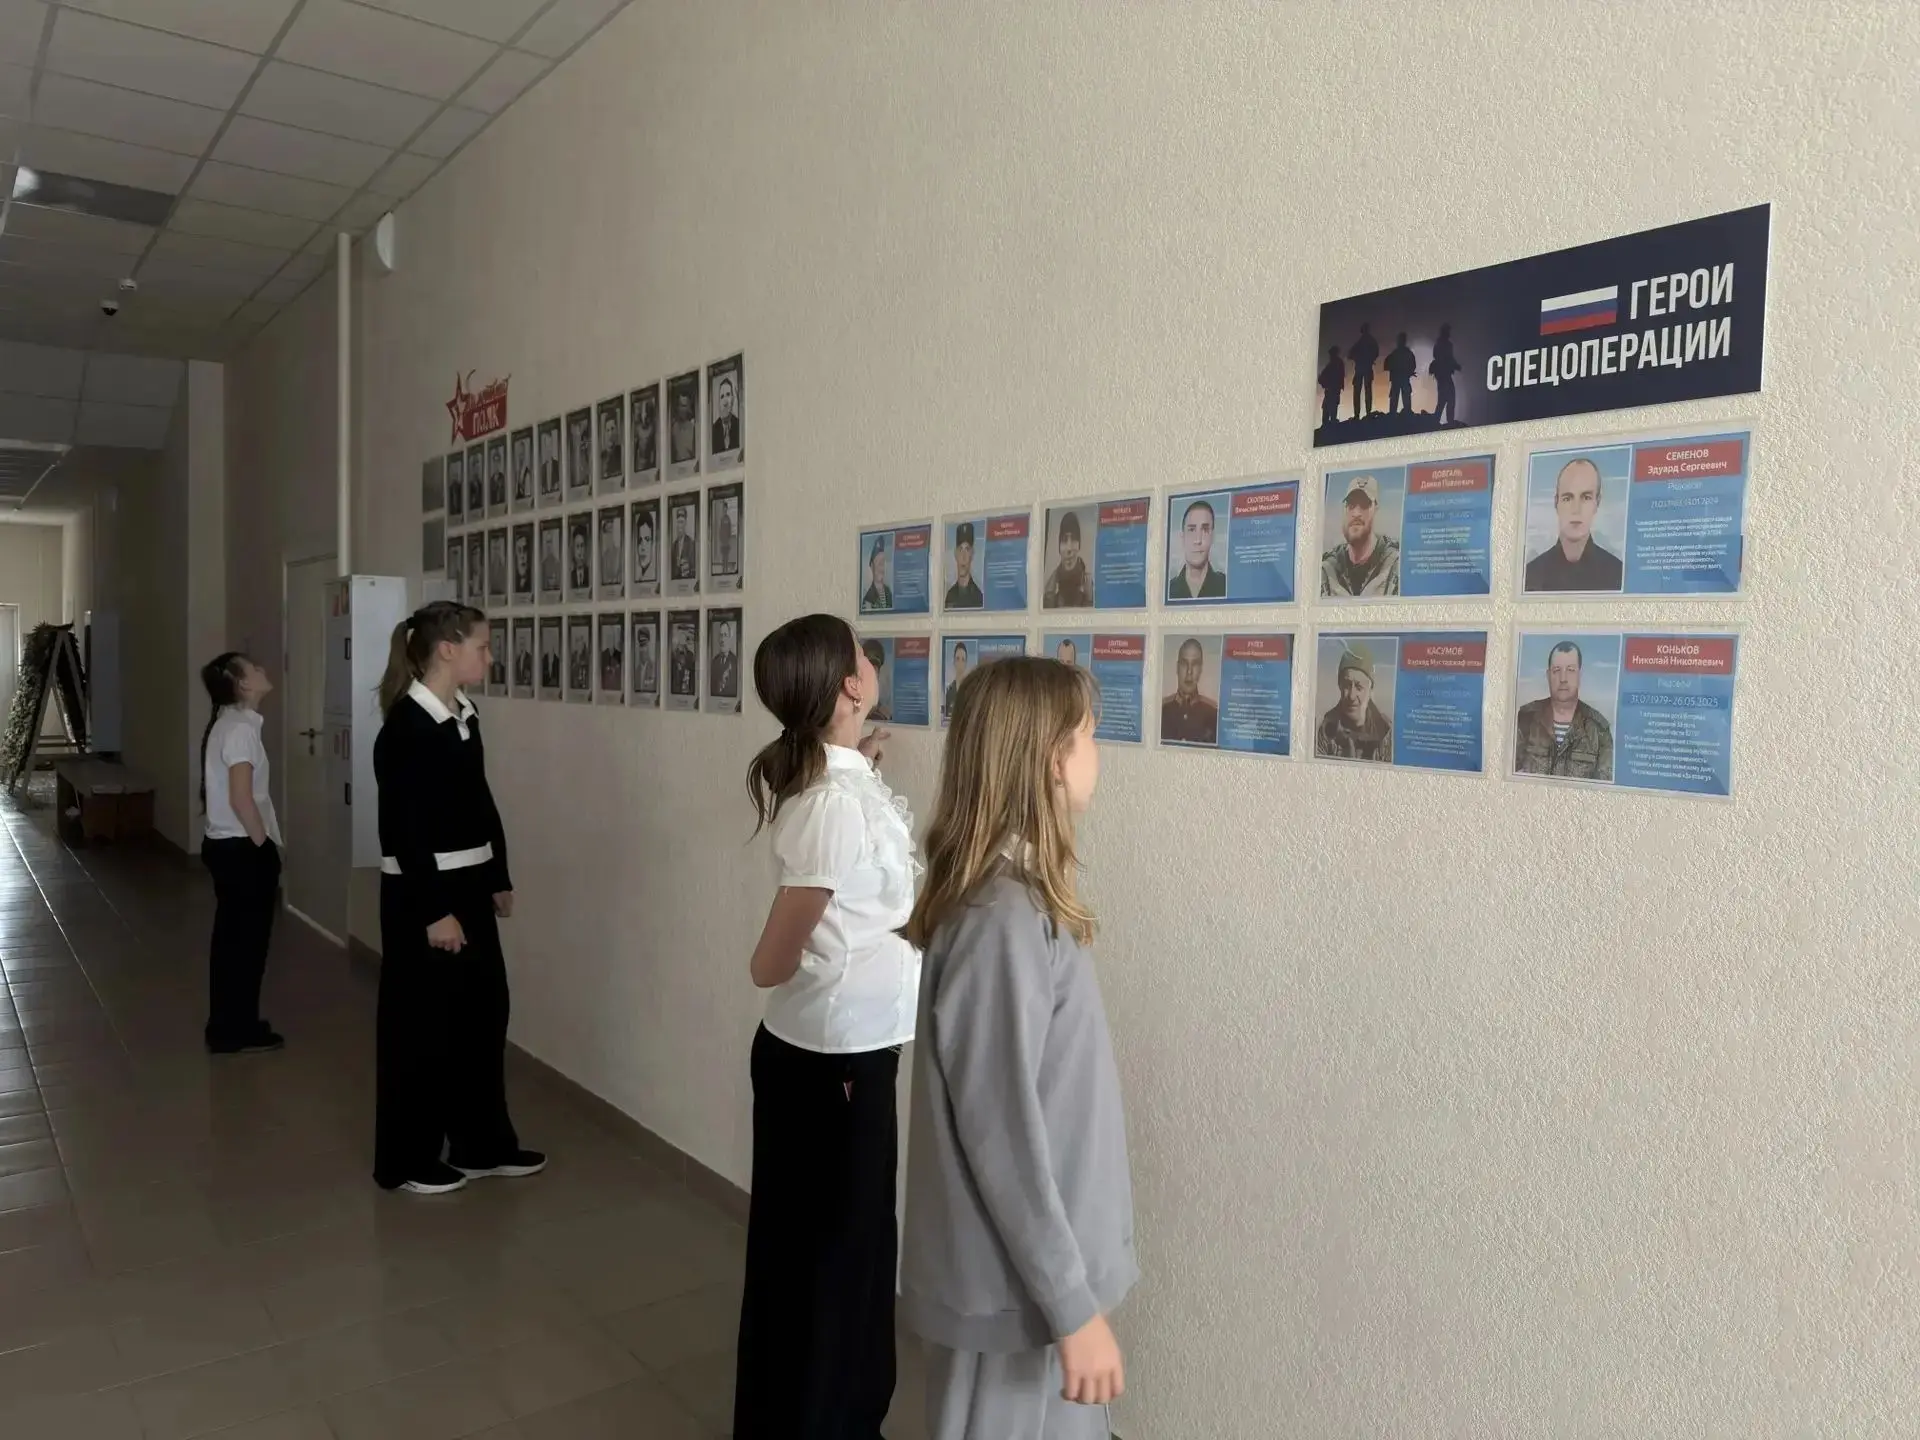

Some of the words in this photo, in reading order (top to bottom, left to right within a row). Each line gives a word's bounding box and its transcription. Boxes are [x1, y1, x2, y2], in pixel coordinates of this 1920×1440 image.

[1630, 262, 1734, 320] ГЕРОИ
[1486, 316, 1731, 391] СПЕЦОПЕРАЦИИ
[1665, 448, 1709, 461] СЕМЕНОВ
[1647, 465, 1679, 476] Эдуард
[1680, 461, 1727, 473] Сергеевич
[1656, 645, 1700, 655] КОНЬКОВ
[1632, 655, 1669, 666] Николай
[1669, 657, 1724, 668] Николаевич
